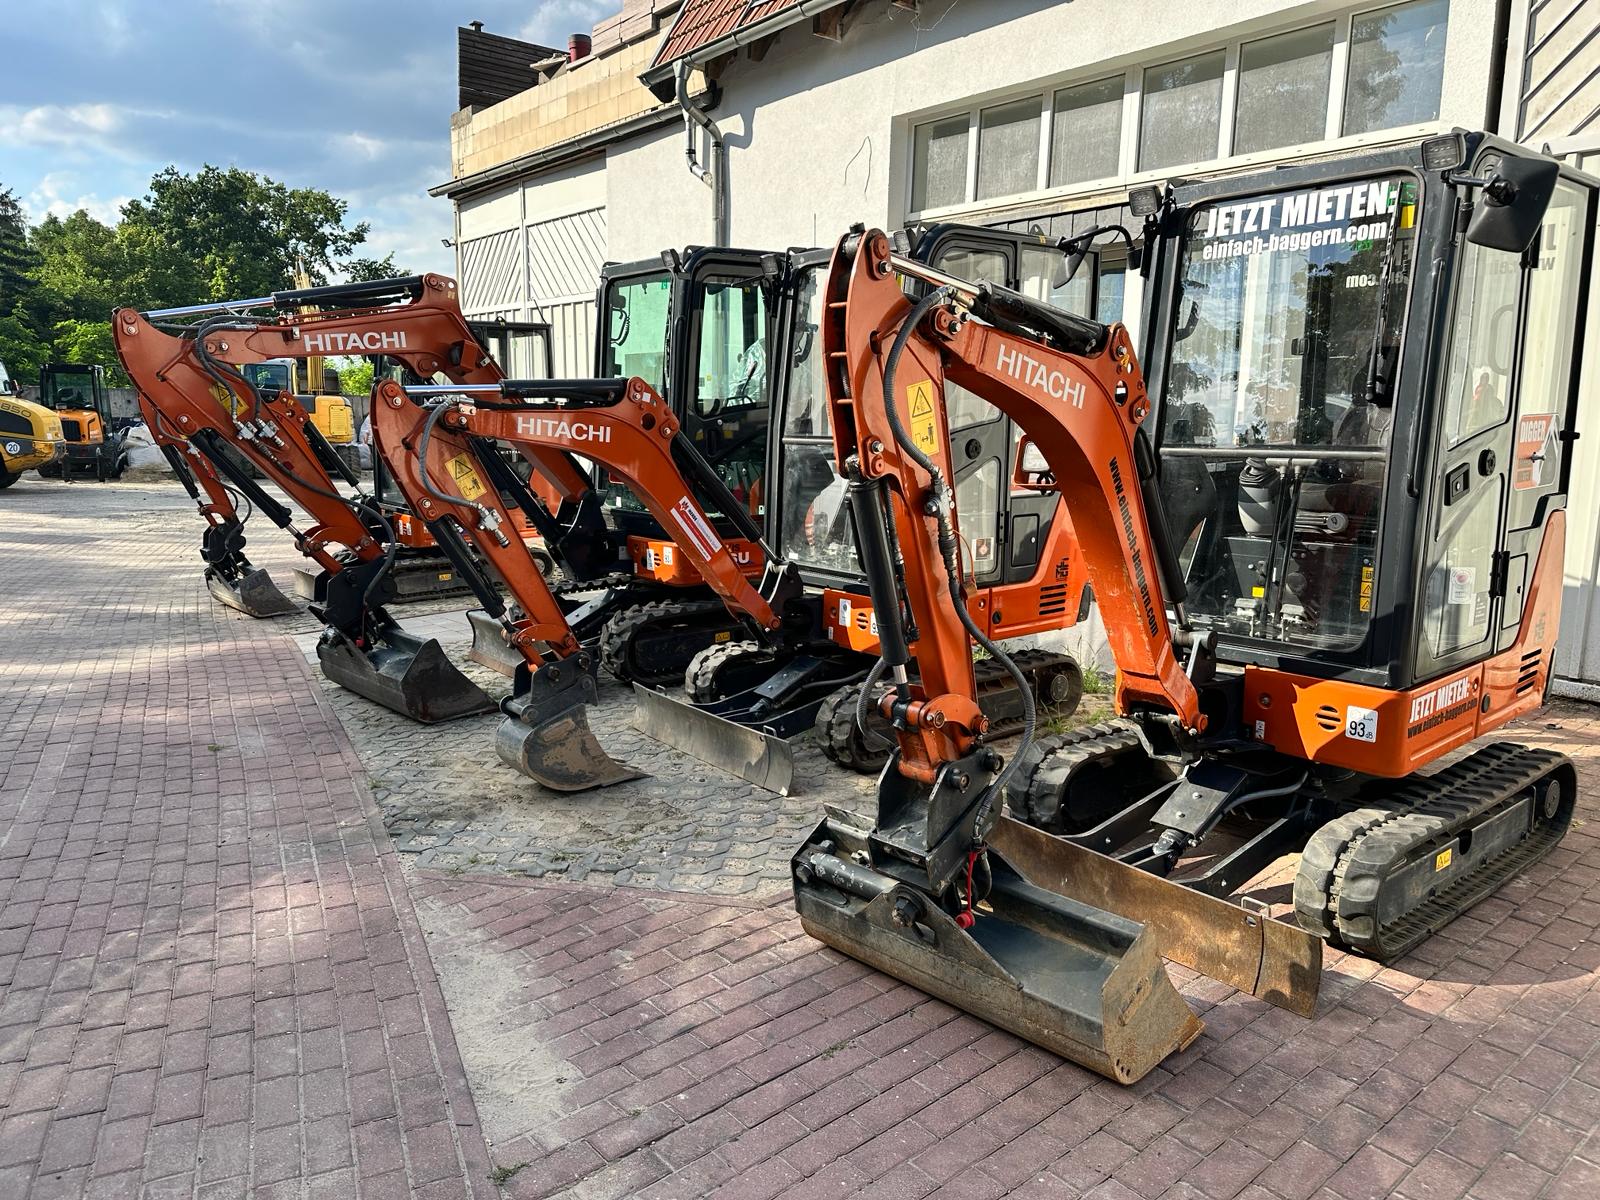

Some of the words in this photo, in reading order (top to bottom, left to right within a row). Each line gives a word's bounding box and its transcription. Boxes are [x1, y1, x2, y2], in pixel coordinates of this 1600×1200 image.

[1203, 199, 1277, 239] JETZT
[1280, 181, 1398, 228] MIETEN:
[1202, 221, 1388, 261] einfach-baggern.com
[303, 331, 407, 352] HITACHI
[996, 343, 1086, 410] HITACHI
[8, 443, 18, 452] 20
[517, 416, 611, 443] HITACHI
[1109, 456, 1159, 638] www.einfach-baggern.com
[1409, 690, 1437, 724] JETZT
[1436, 676, 1470, 710] MIETEN:
[1349, 720, 1366, 738] 93
